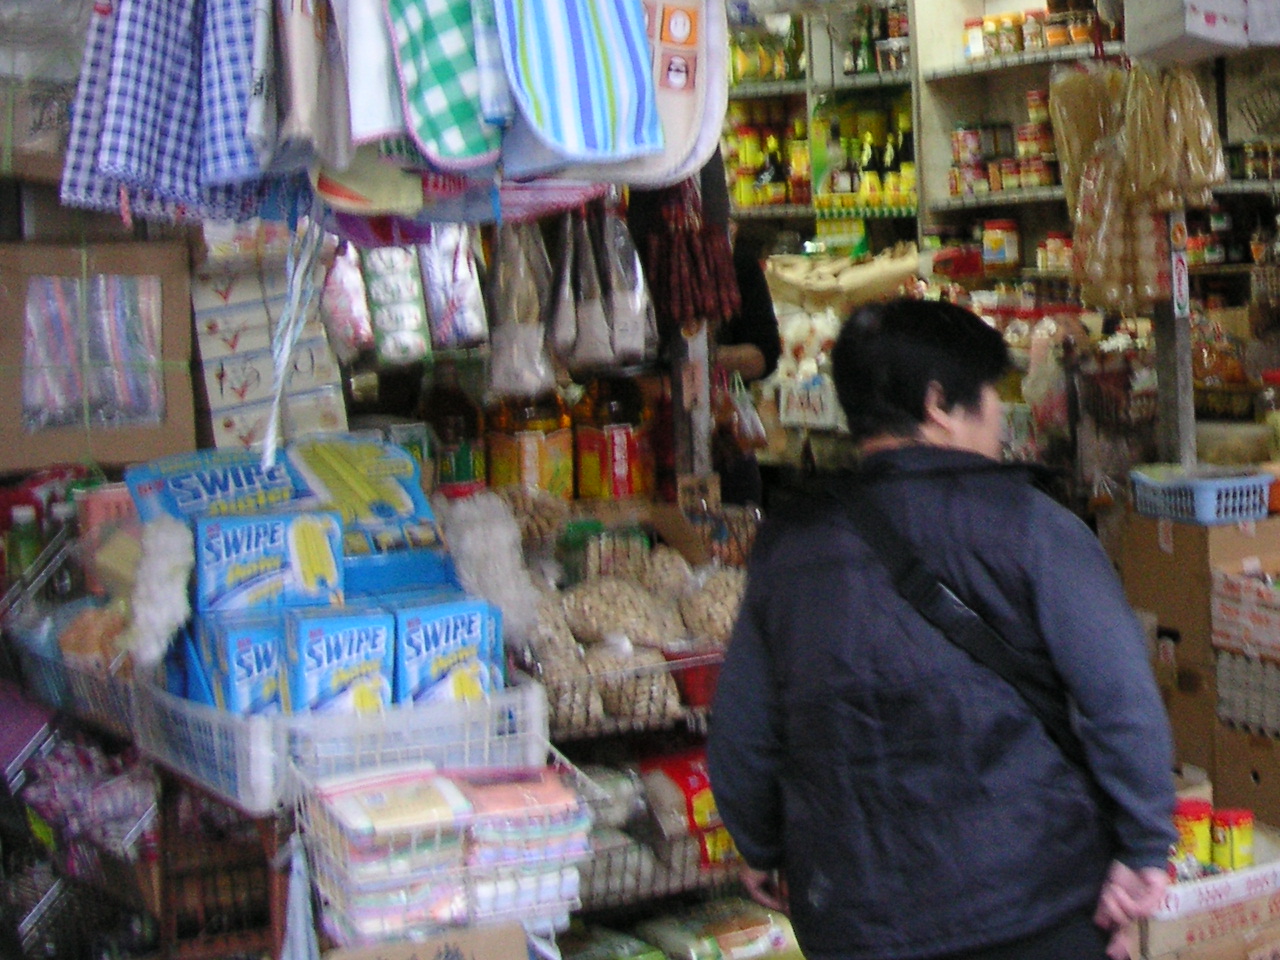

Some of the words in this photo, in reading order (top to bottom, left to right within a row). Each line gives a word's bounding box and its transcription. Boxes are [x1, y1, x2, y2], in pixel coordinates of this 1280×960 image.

[203, 521, 285, 567] SWIPE
[304, 626, 387, 673] SWIPE
[405, 612, 482, 660] SWIPE
